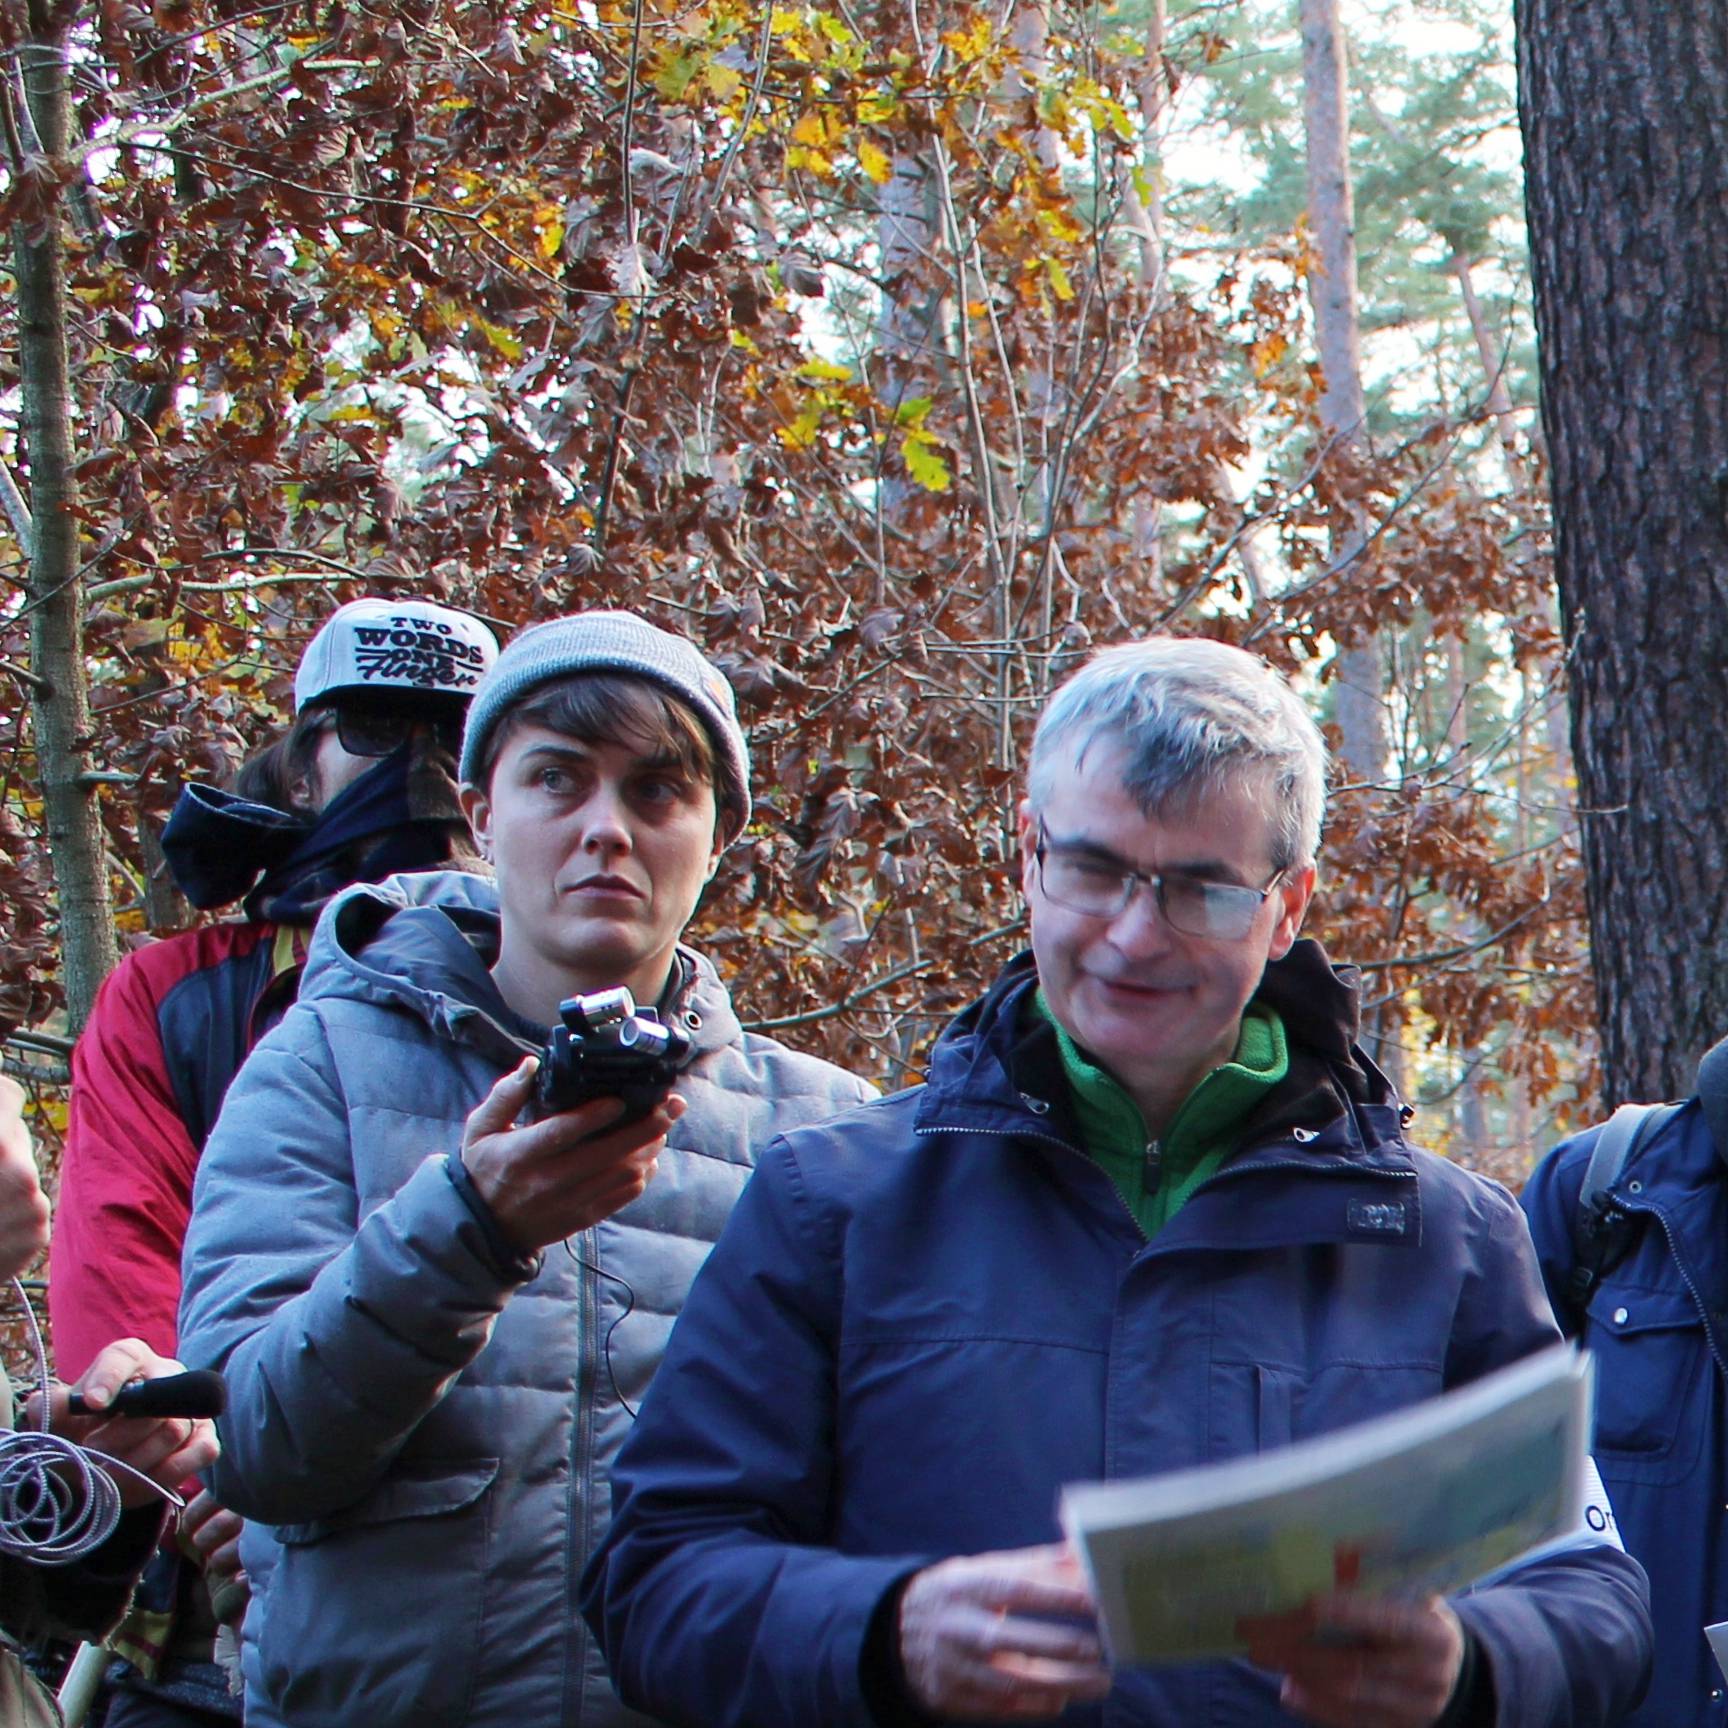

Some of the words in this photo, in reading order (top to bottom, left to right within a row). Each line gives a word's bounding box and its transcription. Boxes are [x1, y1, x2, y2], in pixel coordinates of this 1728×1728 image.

[391, 616, 452, 635] TWO
[354, 627, 484, 664] WORDS
[390, 648, 455, 670] ONE
[356, 654, 479, 688] Finger
